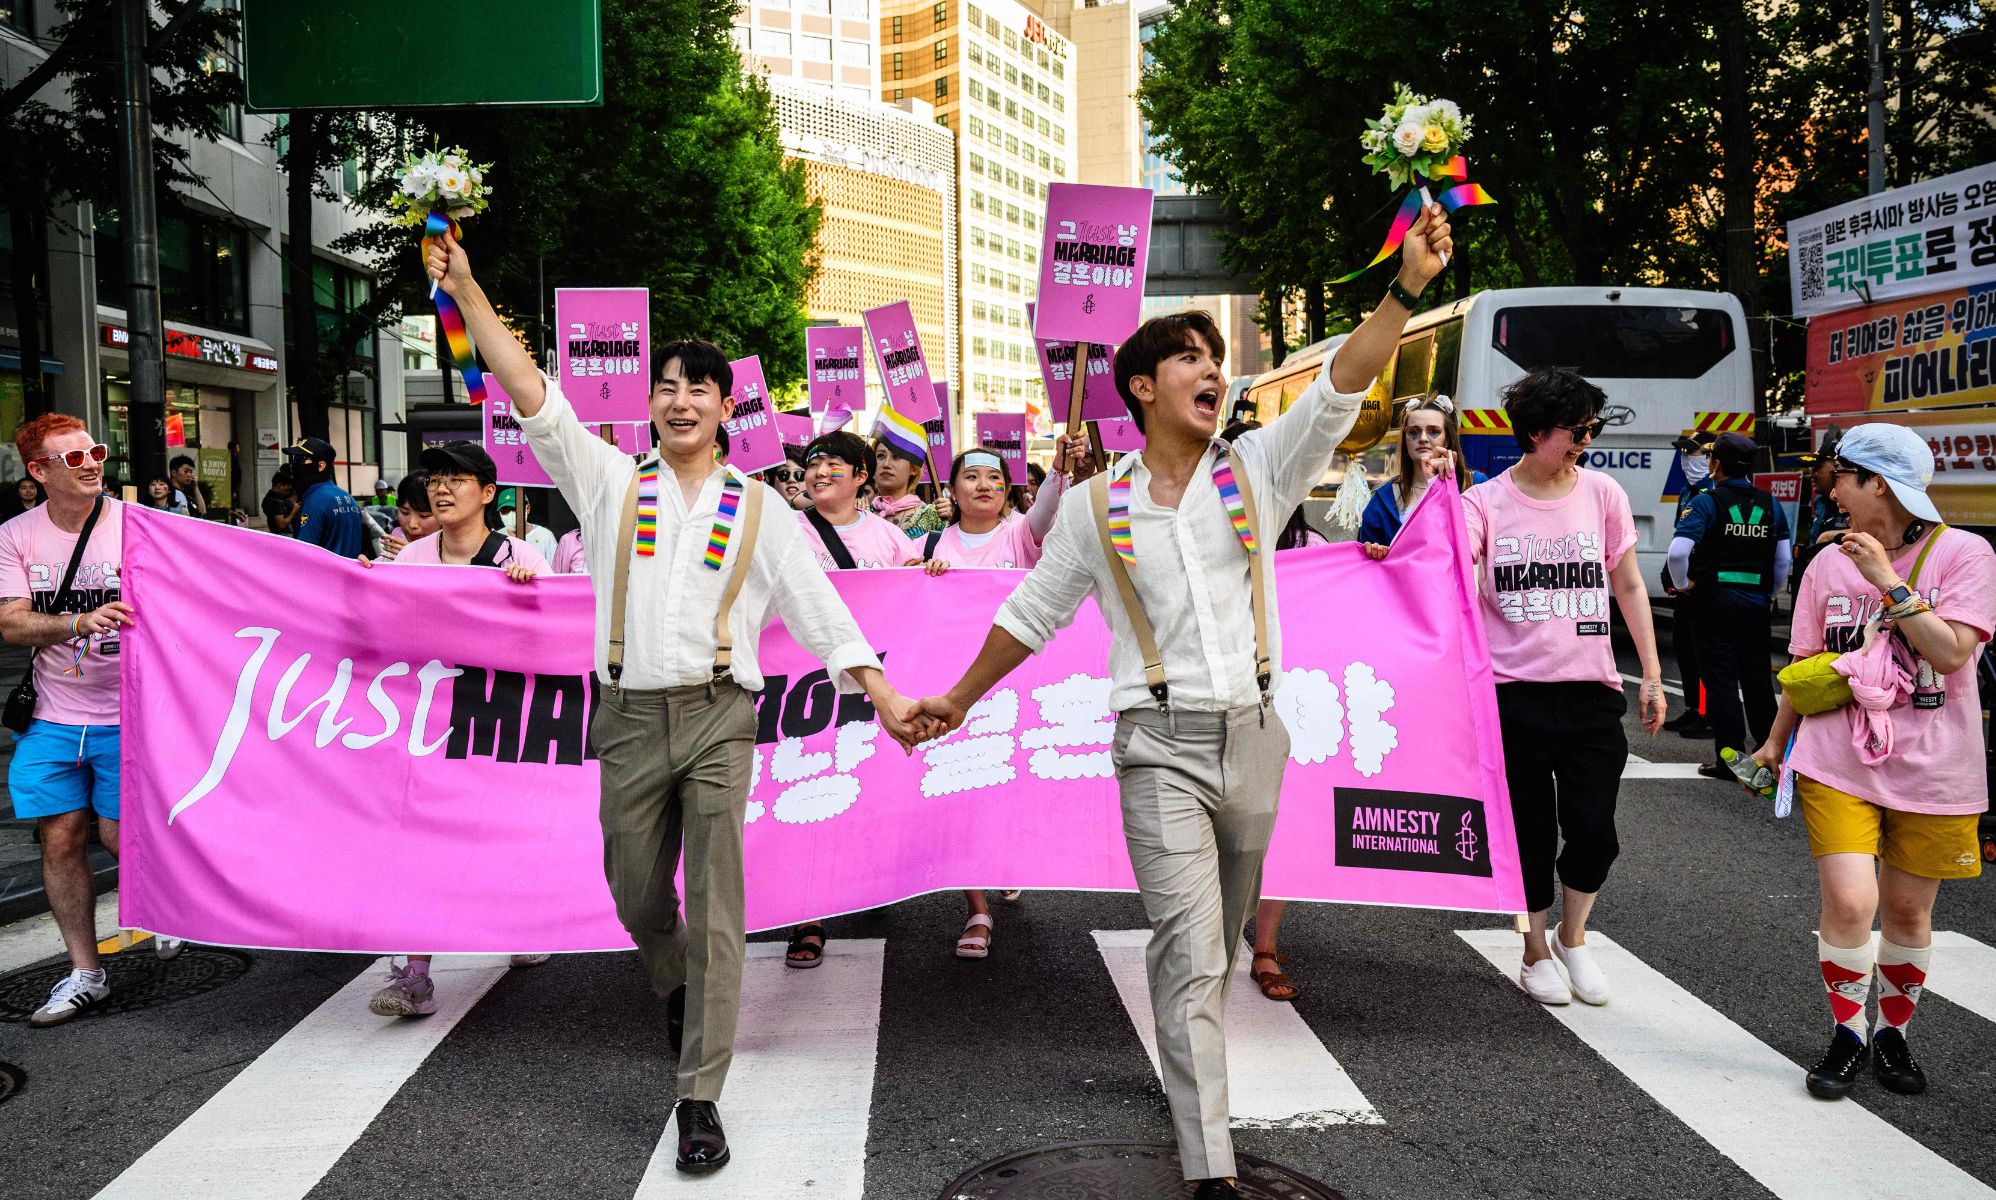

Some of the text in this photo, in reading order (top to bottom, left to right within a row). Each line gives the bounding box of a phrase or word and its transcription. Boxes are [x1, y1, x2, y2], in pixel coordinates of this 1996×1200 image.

[1825, 218, 1846, 245] 일본
[1849, 203, 1904, 238] 후쿠시마
[1908, 192, 1958, 224] 방사능
[1056, 220, 1139, 246] 그 Just 냥
[1054, 241, 1136, 267] MARRIAGE
[1826, 225, 1957, 292] 국민투표로
[1053, 261, 1134, 289] 결혼이야
[568, 321, 639, 343] 그 Just 냥
[1828, 330, 1843, 364] 더
[1847, 316, 1898, 359] 퀴어한
[1903, 304, 1946, 347] 삶을
[569, 340, 639, 357] MARRIAGE
[815, 347, 826, 359] 그
[880, 338, 892, 354] 그
[884, 346, 920, 370] MARRIAGE
[569, 357, 640, 377] 결혼이야
[815, 358, 859, 370] MARRIAGE
[815, 369, 859, 383] 결혼이야
[888, 362, 924, 387] 결혼이야
[1771, 480, 1797, 497] 진보당
[1724, 523, 1769, 538] POLICE
[1494, 536, 1523, 564] 그
[1521, 534, 1576, 572] Just
[1494, 562, 1604, 592] MARRIAGE
[1498, 589, 1606, 623] 결혼이야
[1826, 595, 1852, 625] 그
[168, 625, 465, 827] Just
[1352, 806, 1440, 835] AMNESTY
[1352, 834, 1440, 855] INTERNATIONAL
